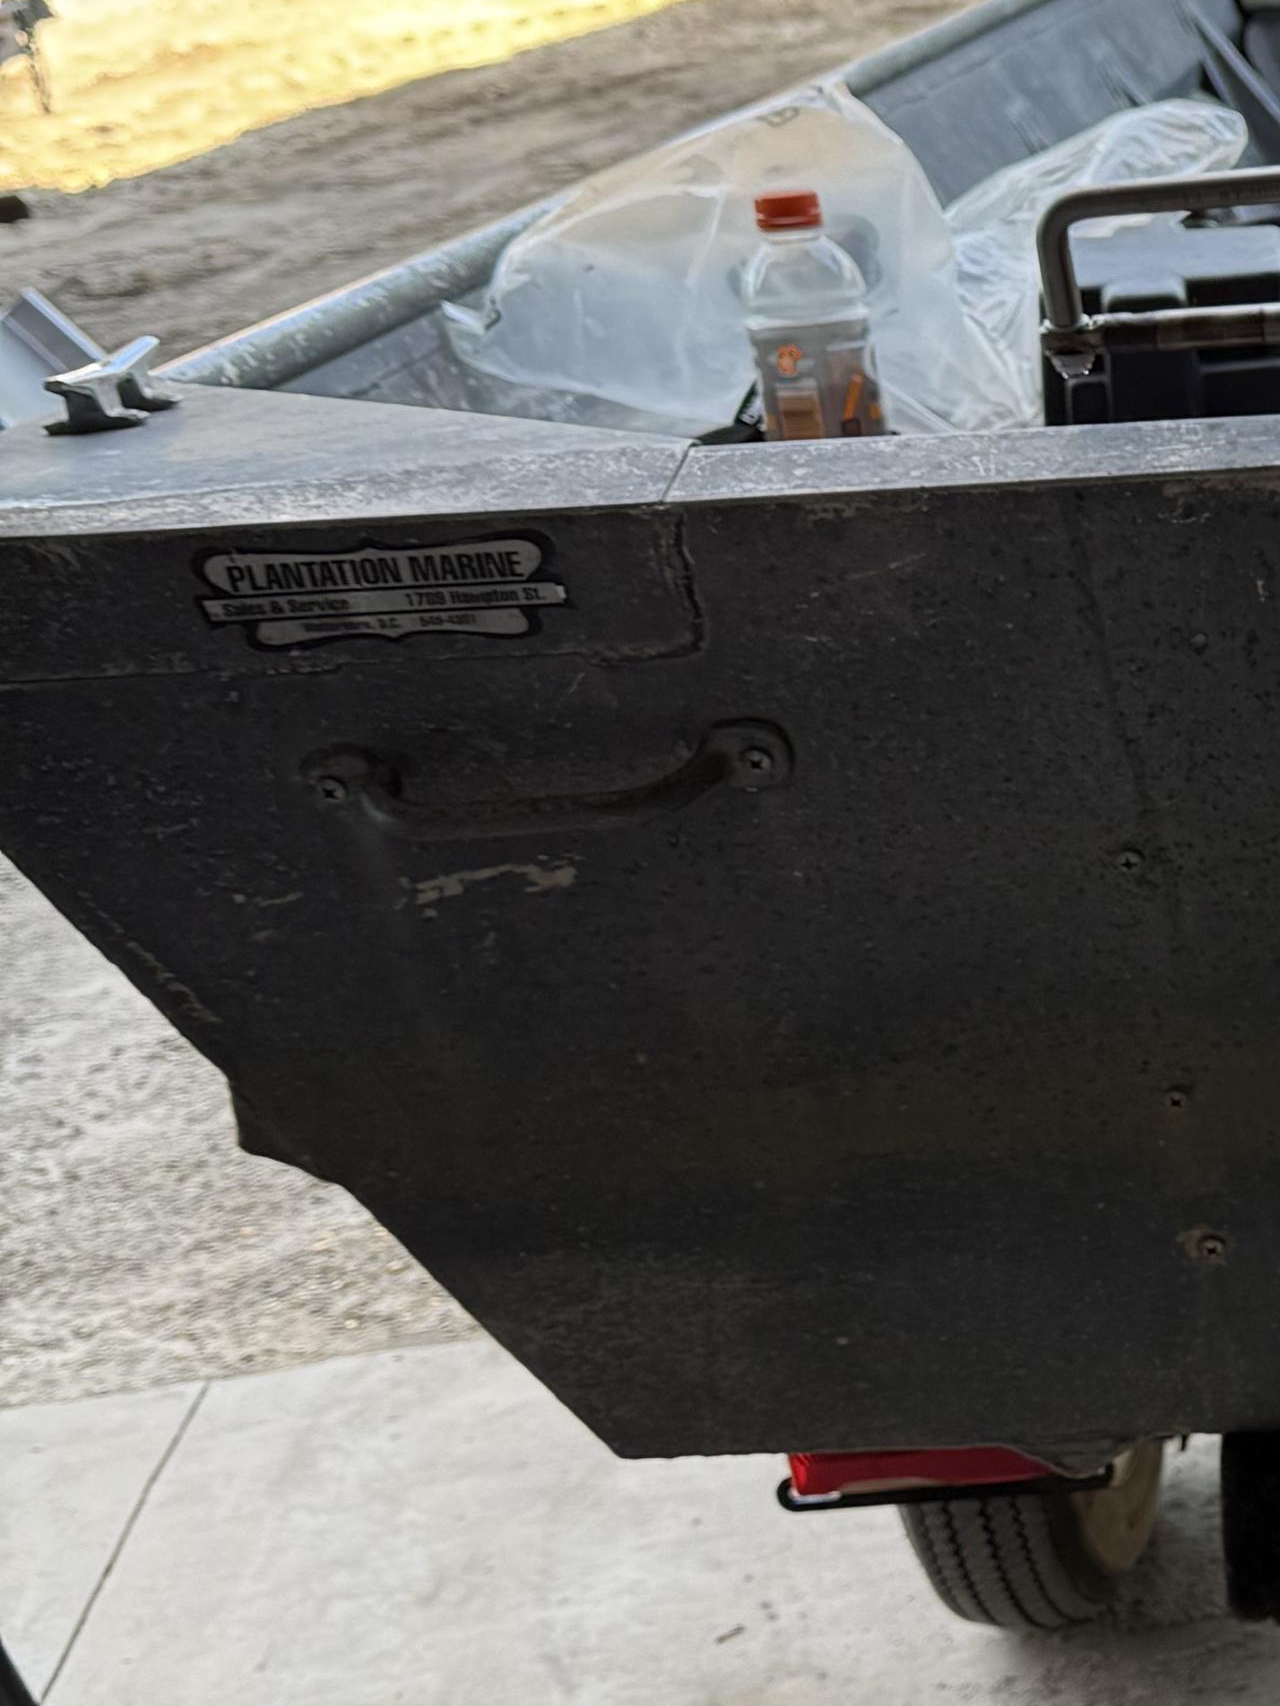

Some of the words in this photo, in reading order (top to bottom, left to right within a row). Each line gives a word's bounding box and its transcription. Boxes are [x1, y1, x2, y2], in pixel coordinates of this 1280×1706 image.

[226, 555, 404, 593] PLANTATION
[408, 550, 525, 583] MARINE
[287, 597, 351, 613] Service
